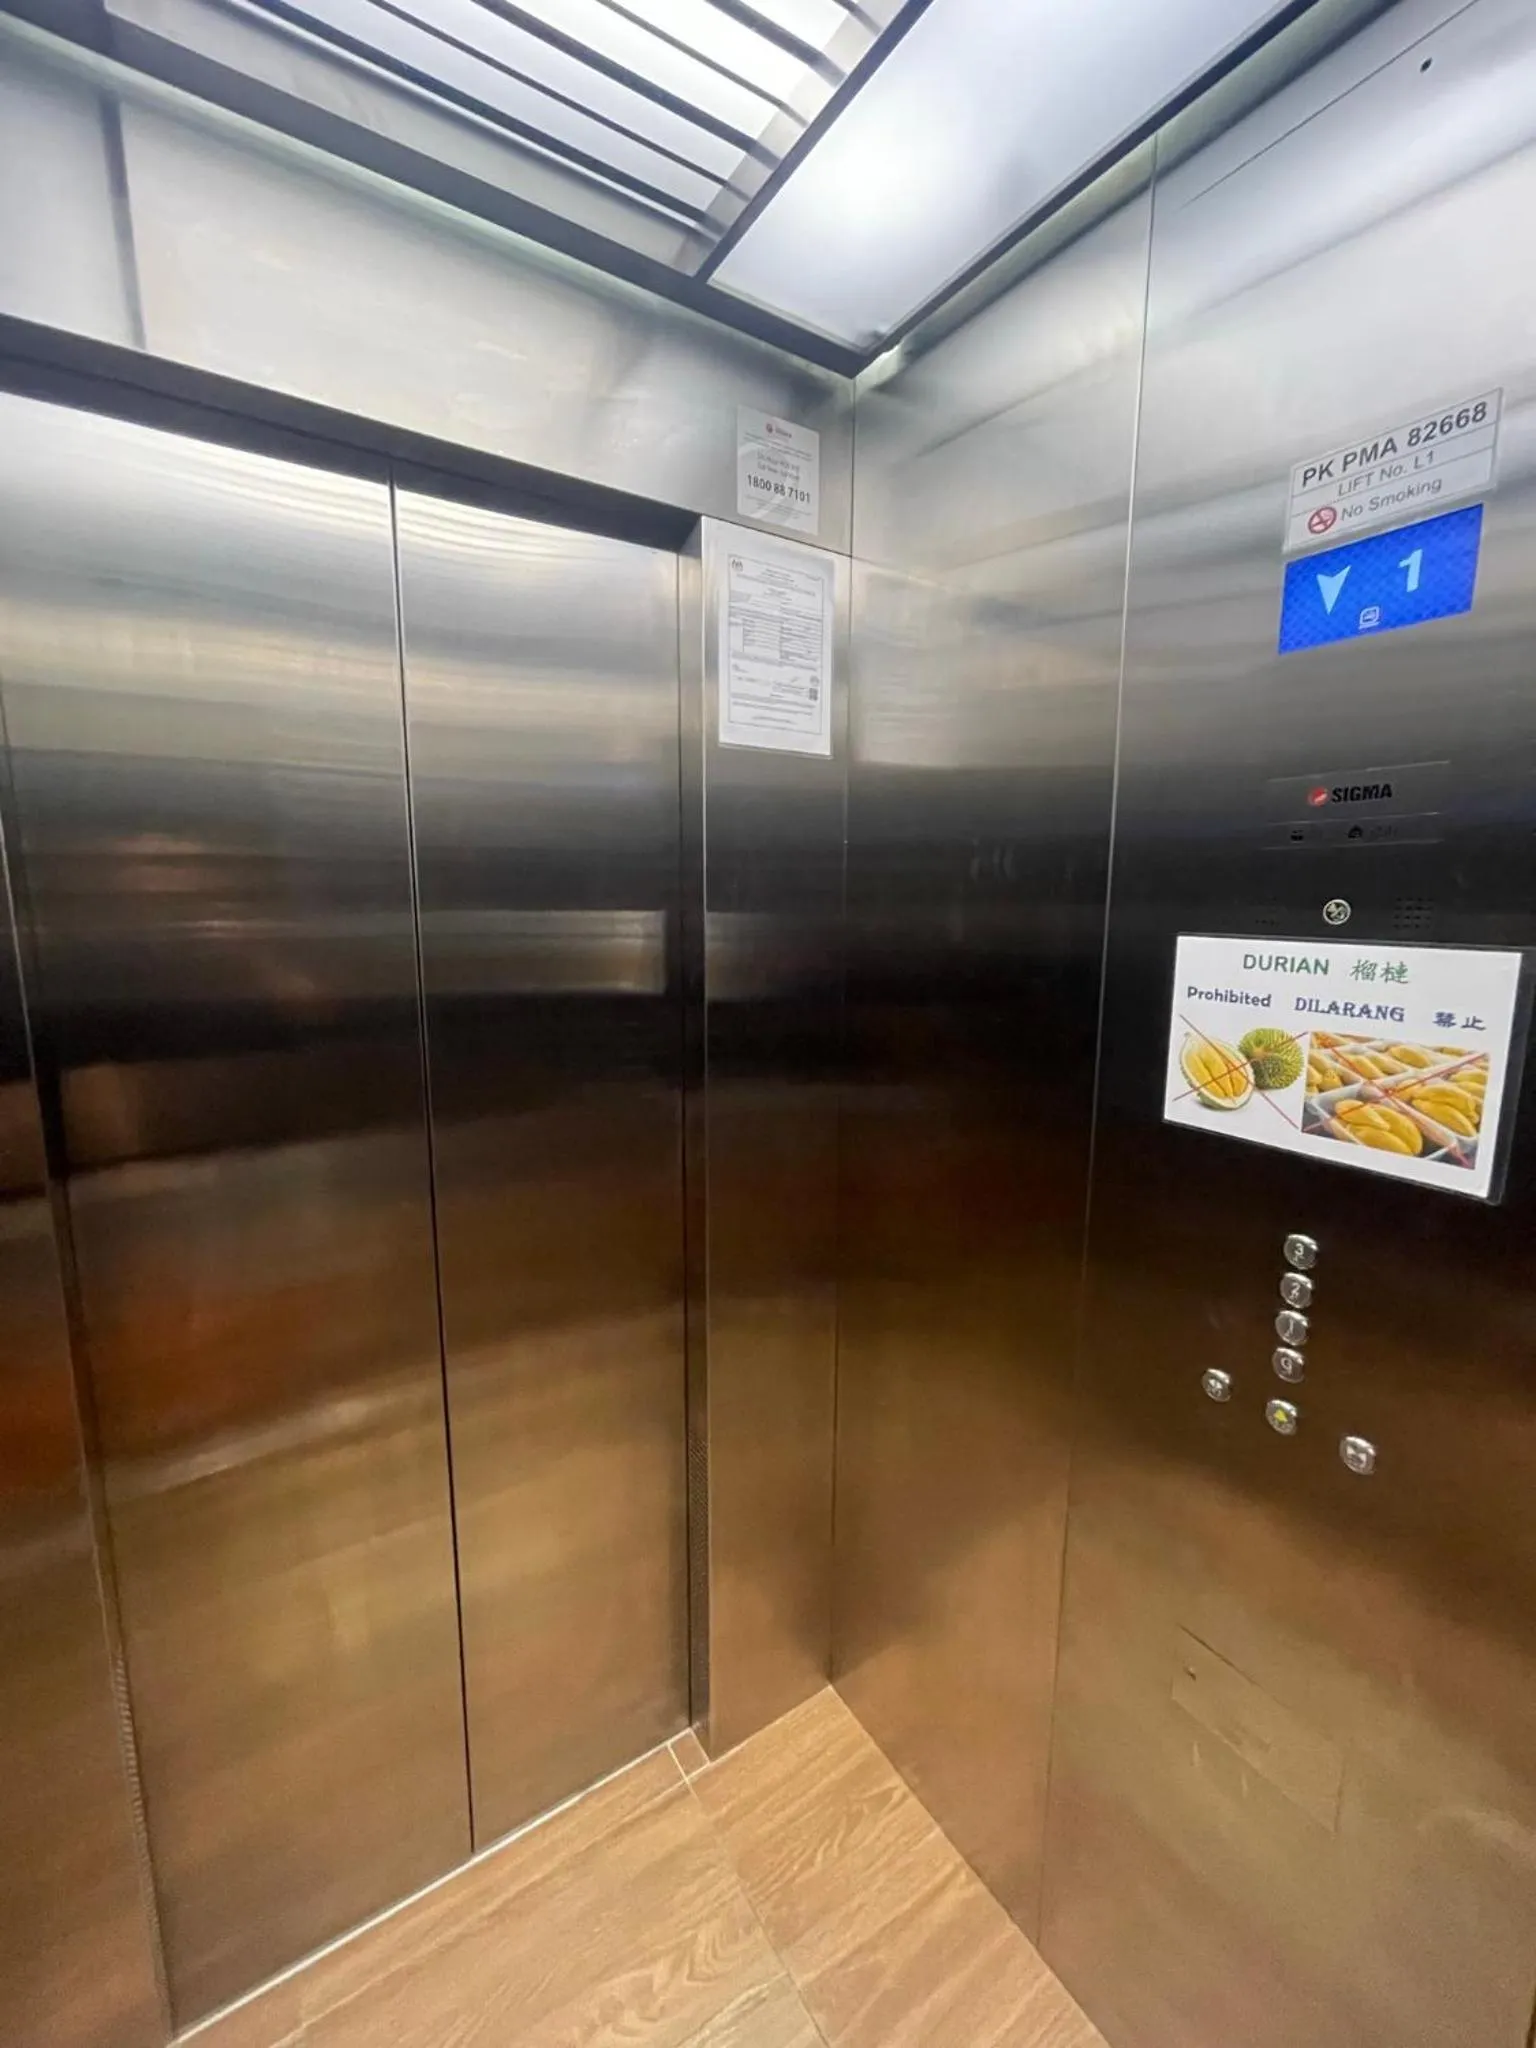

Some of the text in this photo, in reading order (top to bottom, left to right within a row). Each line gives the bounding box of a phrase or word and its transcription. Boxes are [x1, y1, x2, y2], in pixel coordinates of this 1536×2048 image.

[1302, 401, 1488, 488] PK PMA 82668
[747, 474, 810, 503] 1800 88 7101
[1338, 450, 1435, 496] LIFT No. L1
[1341, 478, 1443, 521] No Smoking
[1398, 549, 1423, 592] 1
[1331, 783, 1393, 803] SIGMA
[1243, 953, 1330, 976] DURIAN
[1187, 986, 1405, 1023] Prohibited DILARANG
[1432, 1011, 1487, 1031] 禁止
